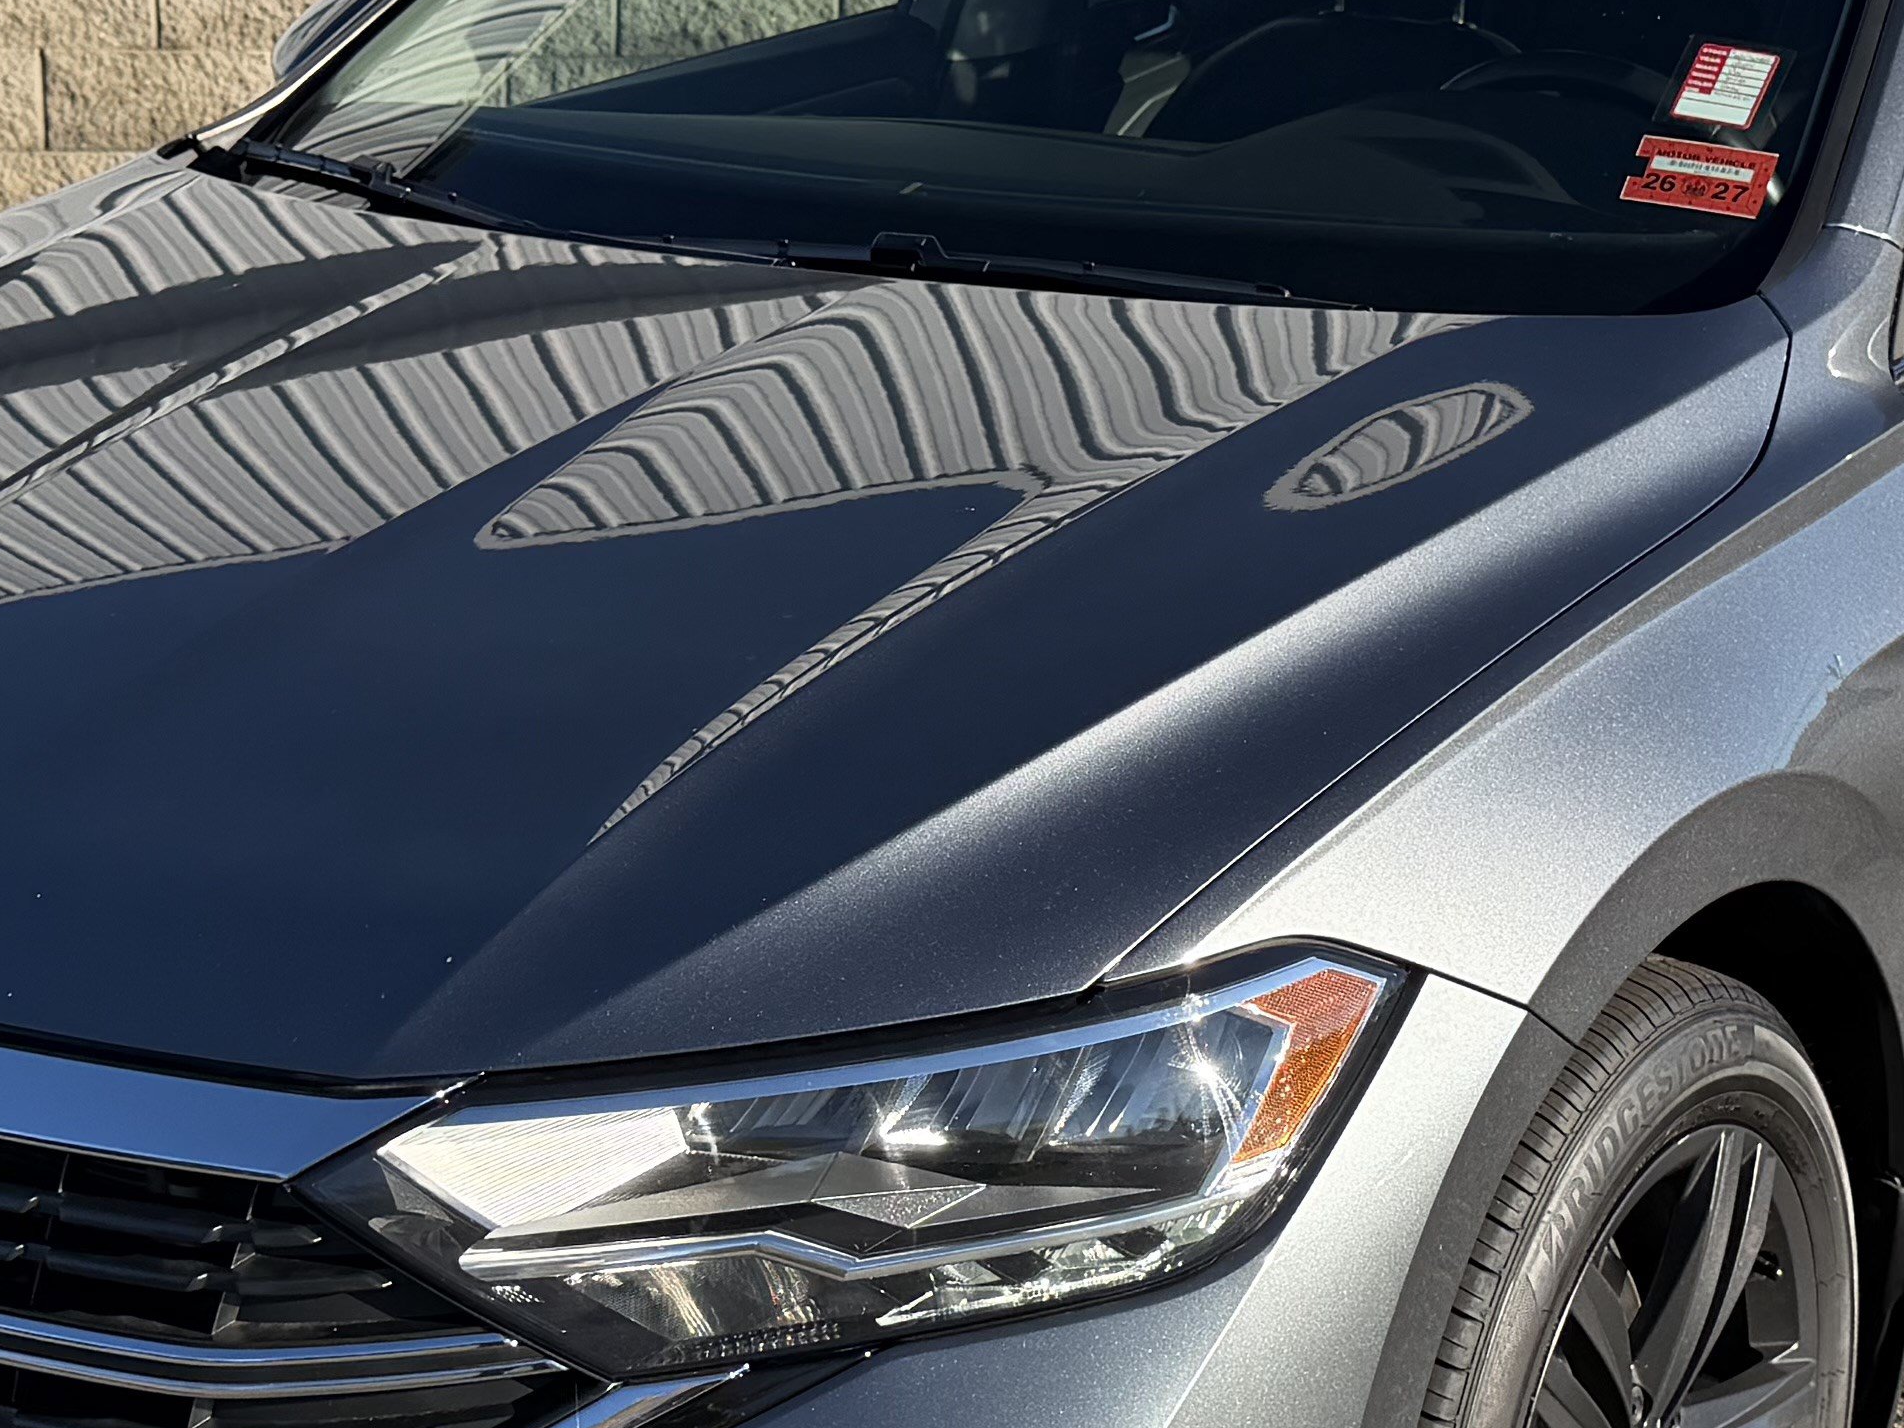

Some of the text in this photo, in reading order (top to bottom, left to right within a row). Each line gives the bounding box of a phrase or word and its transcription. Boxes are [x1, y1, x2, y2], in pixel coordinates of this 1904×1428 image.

[1657, 149, 1700, 161] MOTOR
[1705, 155, 1756, 169] VEHICLE
[1641, 172, 1750, 203] 26 27
